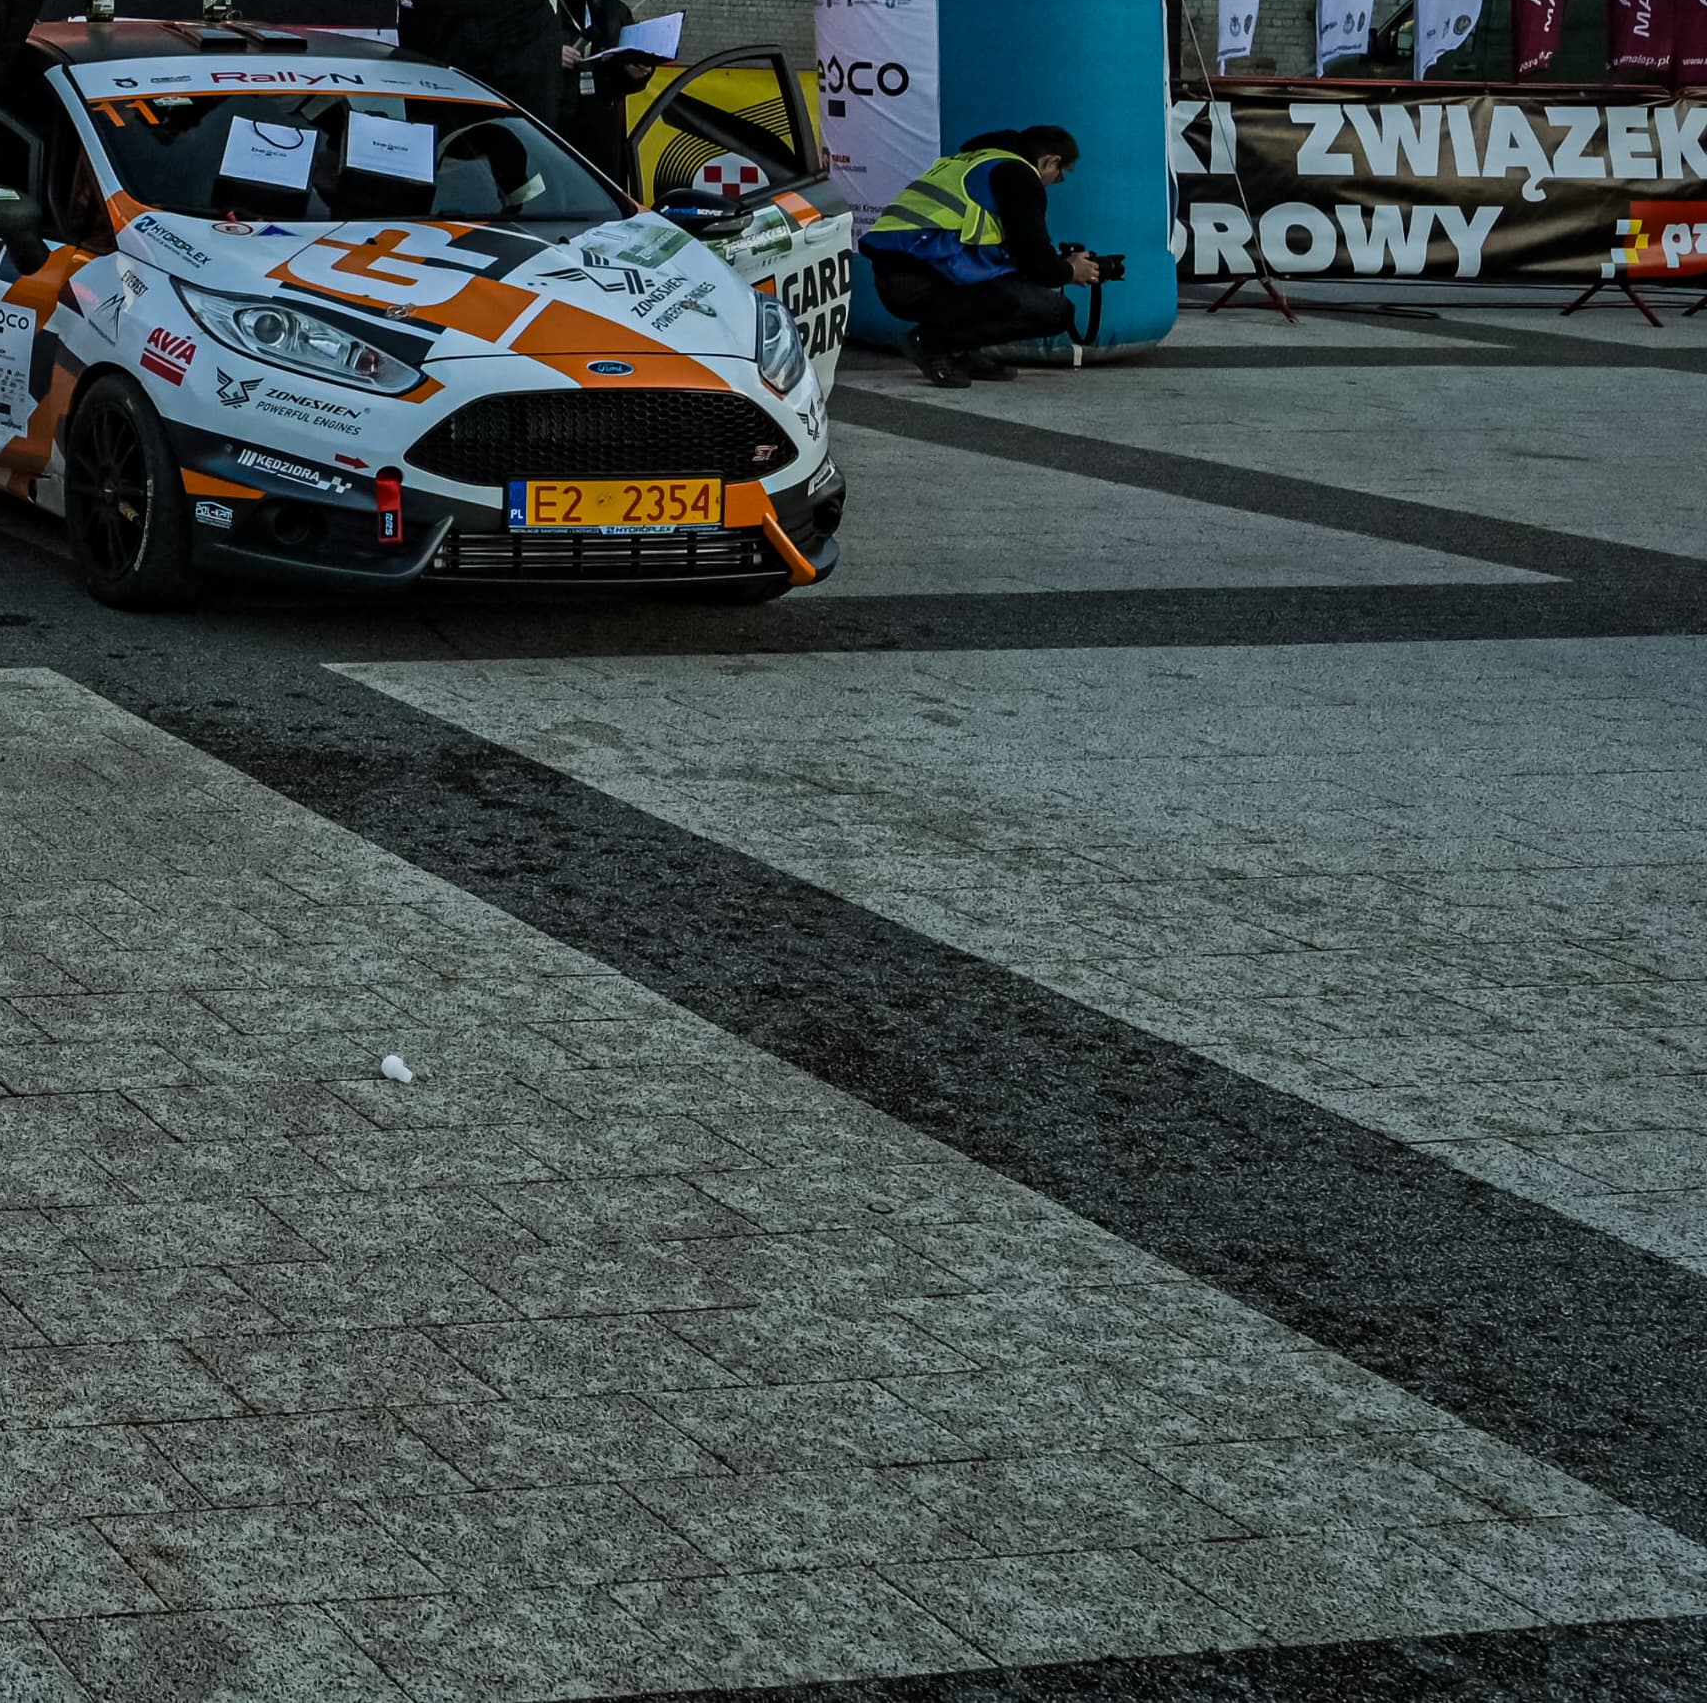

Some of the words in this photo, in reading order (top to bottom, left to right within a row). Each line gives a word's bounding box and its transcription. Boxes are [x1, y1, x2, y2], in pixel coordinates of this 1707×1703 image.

[210, 71, 365, 85] RallyN
[1289, 102, 1707, 201] ZWIĄZEK
[151, 224, 212, 266] HYDROPLEX
[1171, 202, 1504, 278] ROWY
[121, 269, 148, 298] EVEREST
[631, 275, 688, 318] ZONGSHEN
[596, 362, 624, 374] Ford
[255, 400, 310, 423] POWERFUL
[313, 415, 362, 436] ENGINES
[265, 387, 363, 420] ZONGSHEN
[256, 454, 321, 482] KĘDZIORA
[751, 444, 778, 462] ST
[510, 509, 523, 519] PL
[535, 485, 583, 523] E2
[622, 483, 710, 522] 2354
